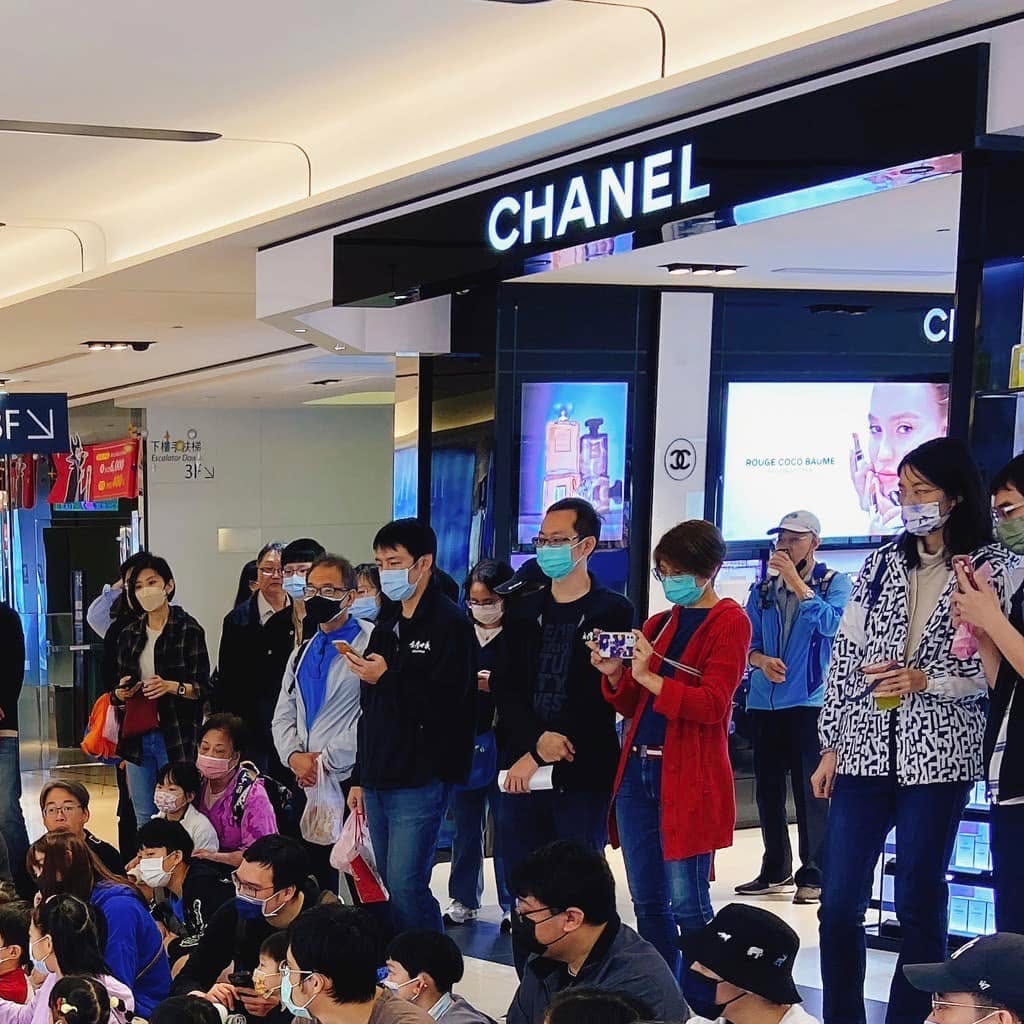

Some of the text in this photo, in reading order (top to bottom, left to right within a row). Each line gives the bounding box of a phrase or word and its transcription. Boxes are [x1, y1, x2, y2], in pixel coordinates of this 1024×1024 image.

[488, 144, 711, 251] CHANEL
[924, 308, 955, 342] C
[745, 457, 836, 467] ROUGE COCO BAUME
